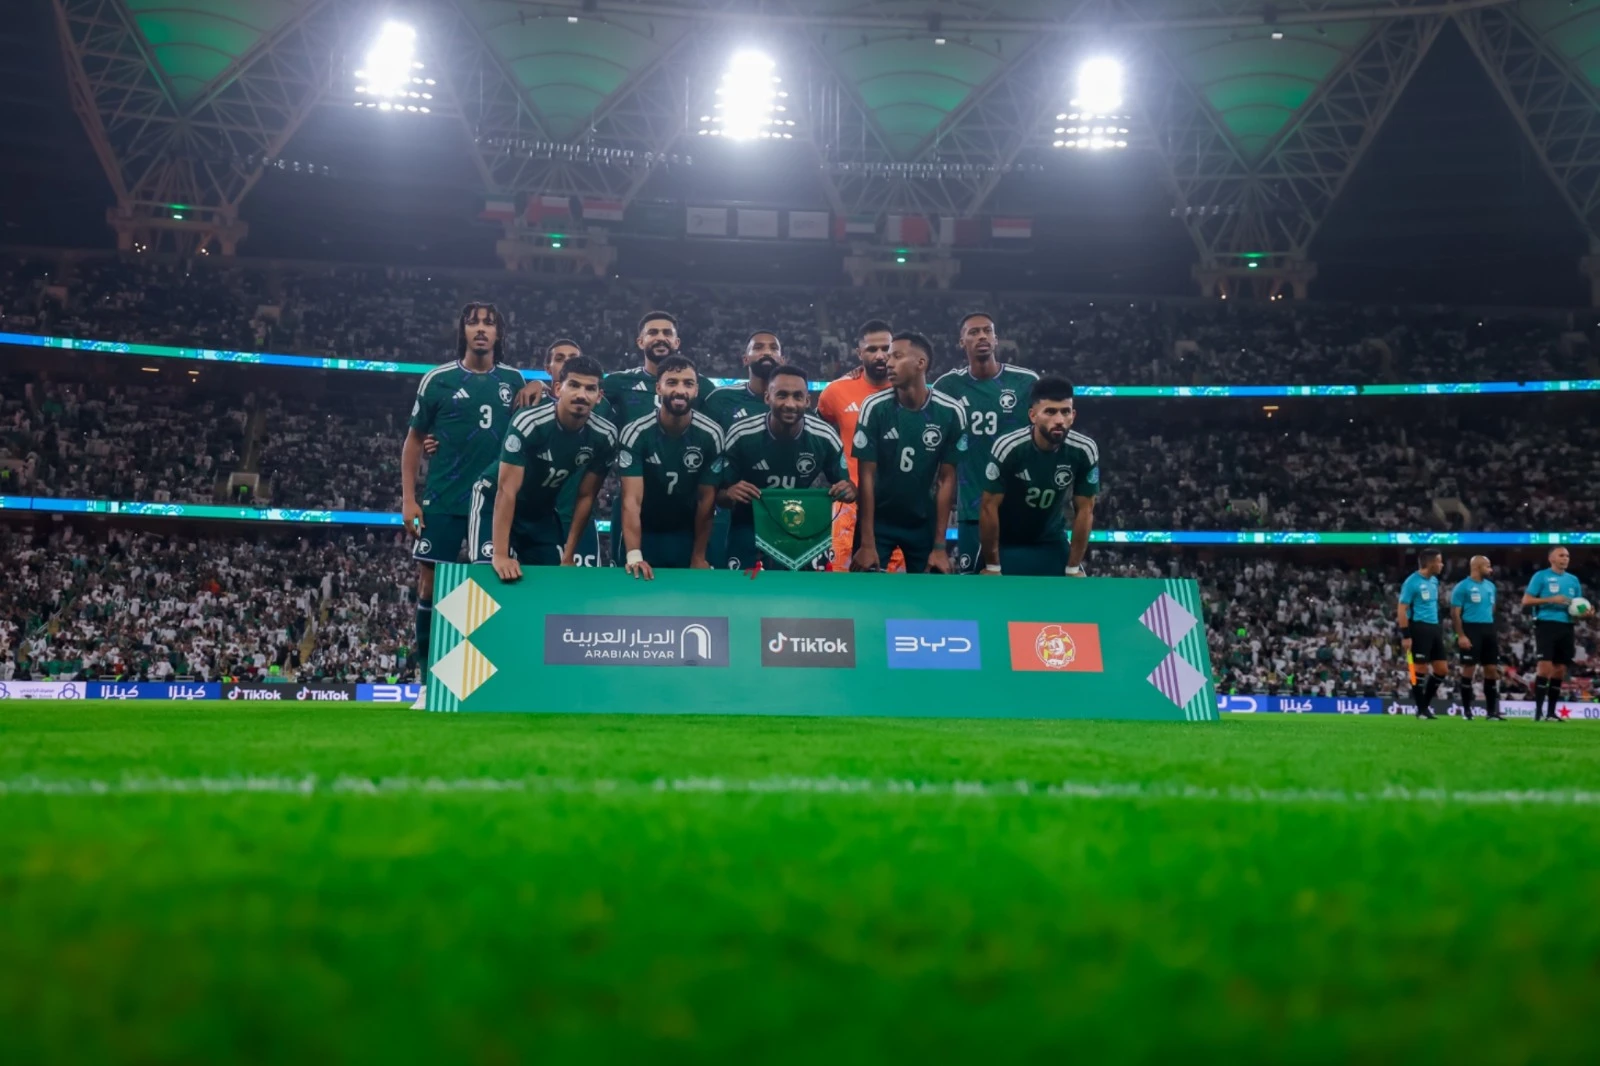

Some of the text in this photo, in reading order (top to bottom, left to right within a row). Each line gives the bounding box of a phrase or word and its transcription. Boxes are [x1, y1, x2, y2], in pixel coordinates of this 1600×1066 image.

[479, 404, 493, 429] 3
[971, 410, 997, 436] 23
[899, 446, 915, 473] 6
[541, 466, 569, 488] 12
[666, 471, 679, 495] 7
[1025, 487, 1056, 509] 20
[563, 628, 675, 648] الديار العربية
[789, 637, 848, 653] TikTok
[895, 636, 972, 652] BYD
[584, 650, 675, 660] ARABIAN DYAR
[242, 689, 281, 700] TikTok
[311, 690, 349, 701] TikTok
